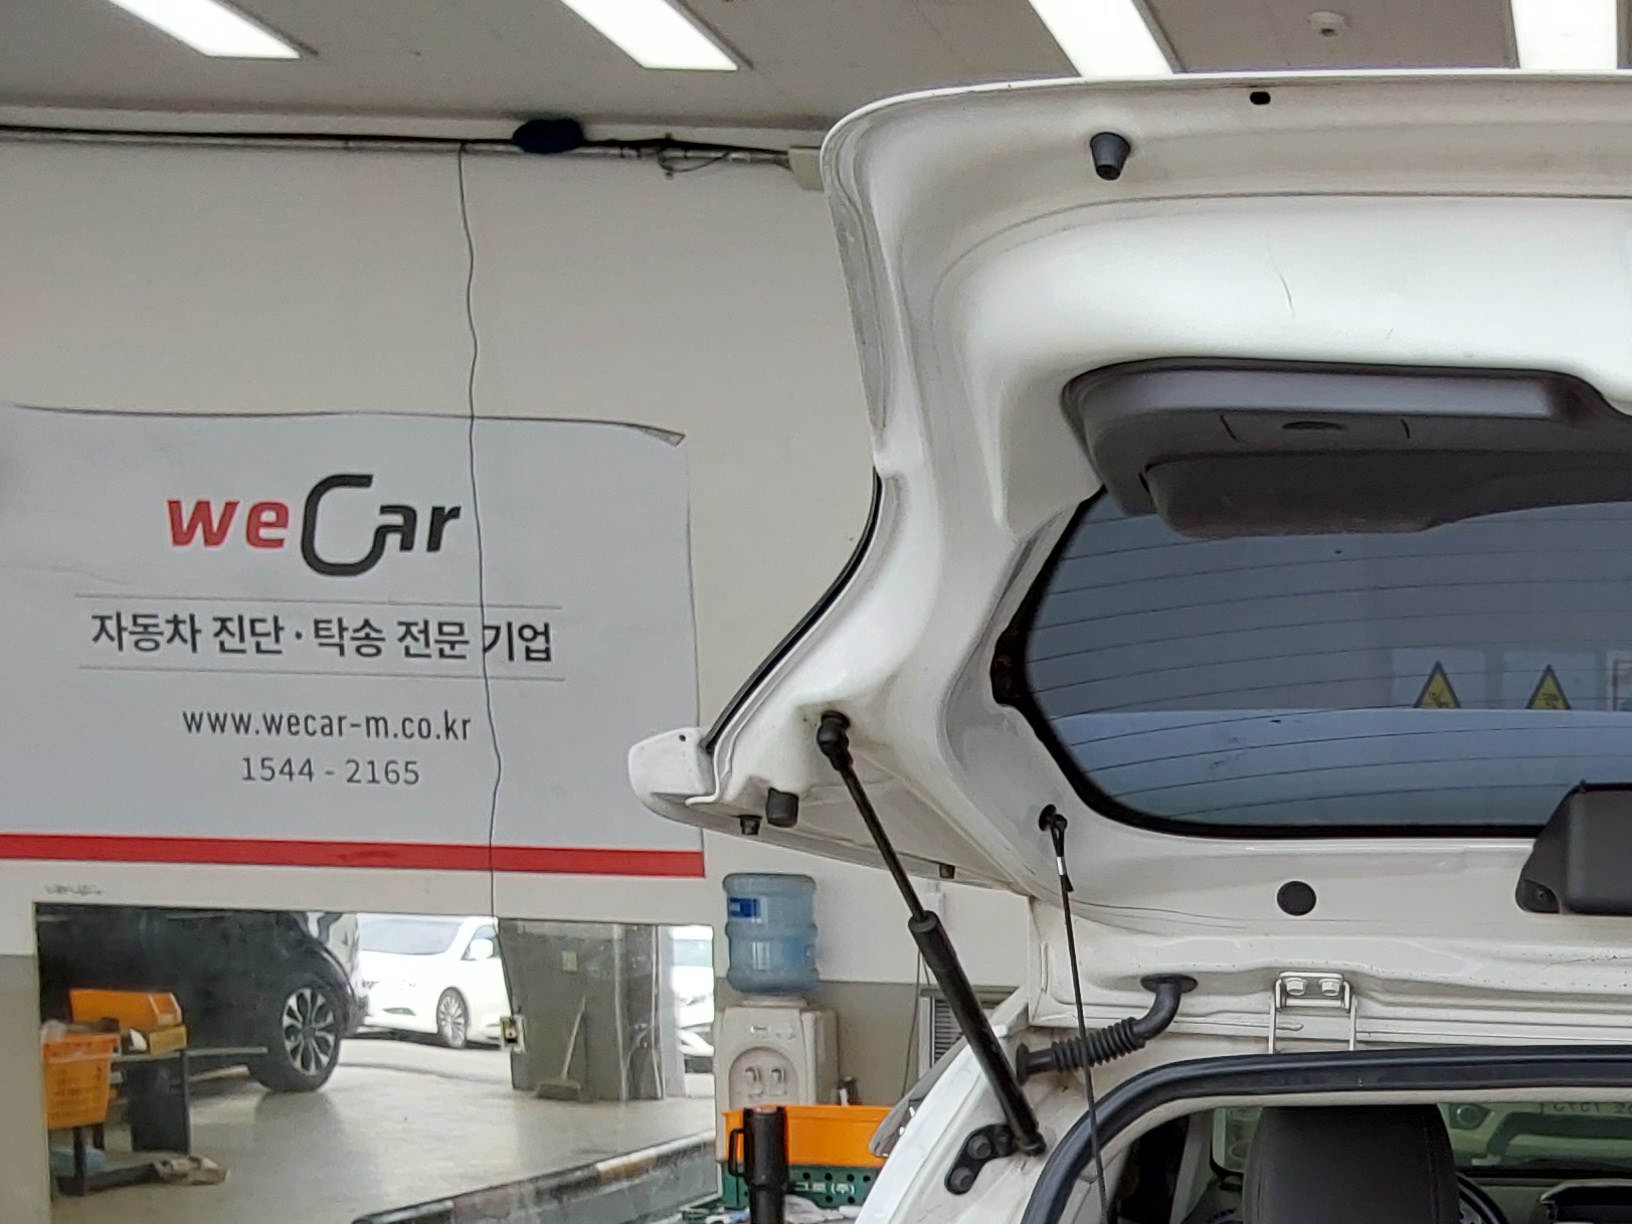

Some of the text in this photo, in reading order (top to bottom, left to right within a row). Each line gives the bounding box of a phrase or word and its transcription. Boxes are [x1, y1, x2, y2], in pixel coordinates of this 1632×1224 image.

[91, 611, 202, 654] 자동차
[396, 618, 470, 661] 전문
[485, 621, 553, 663] 기업
[182, 709, 471, 742] www.wecar-m.co.kr
